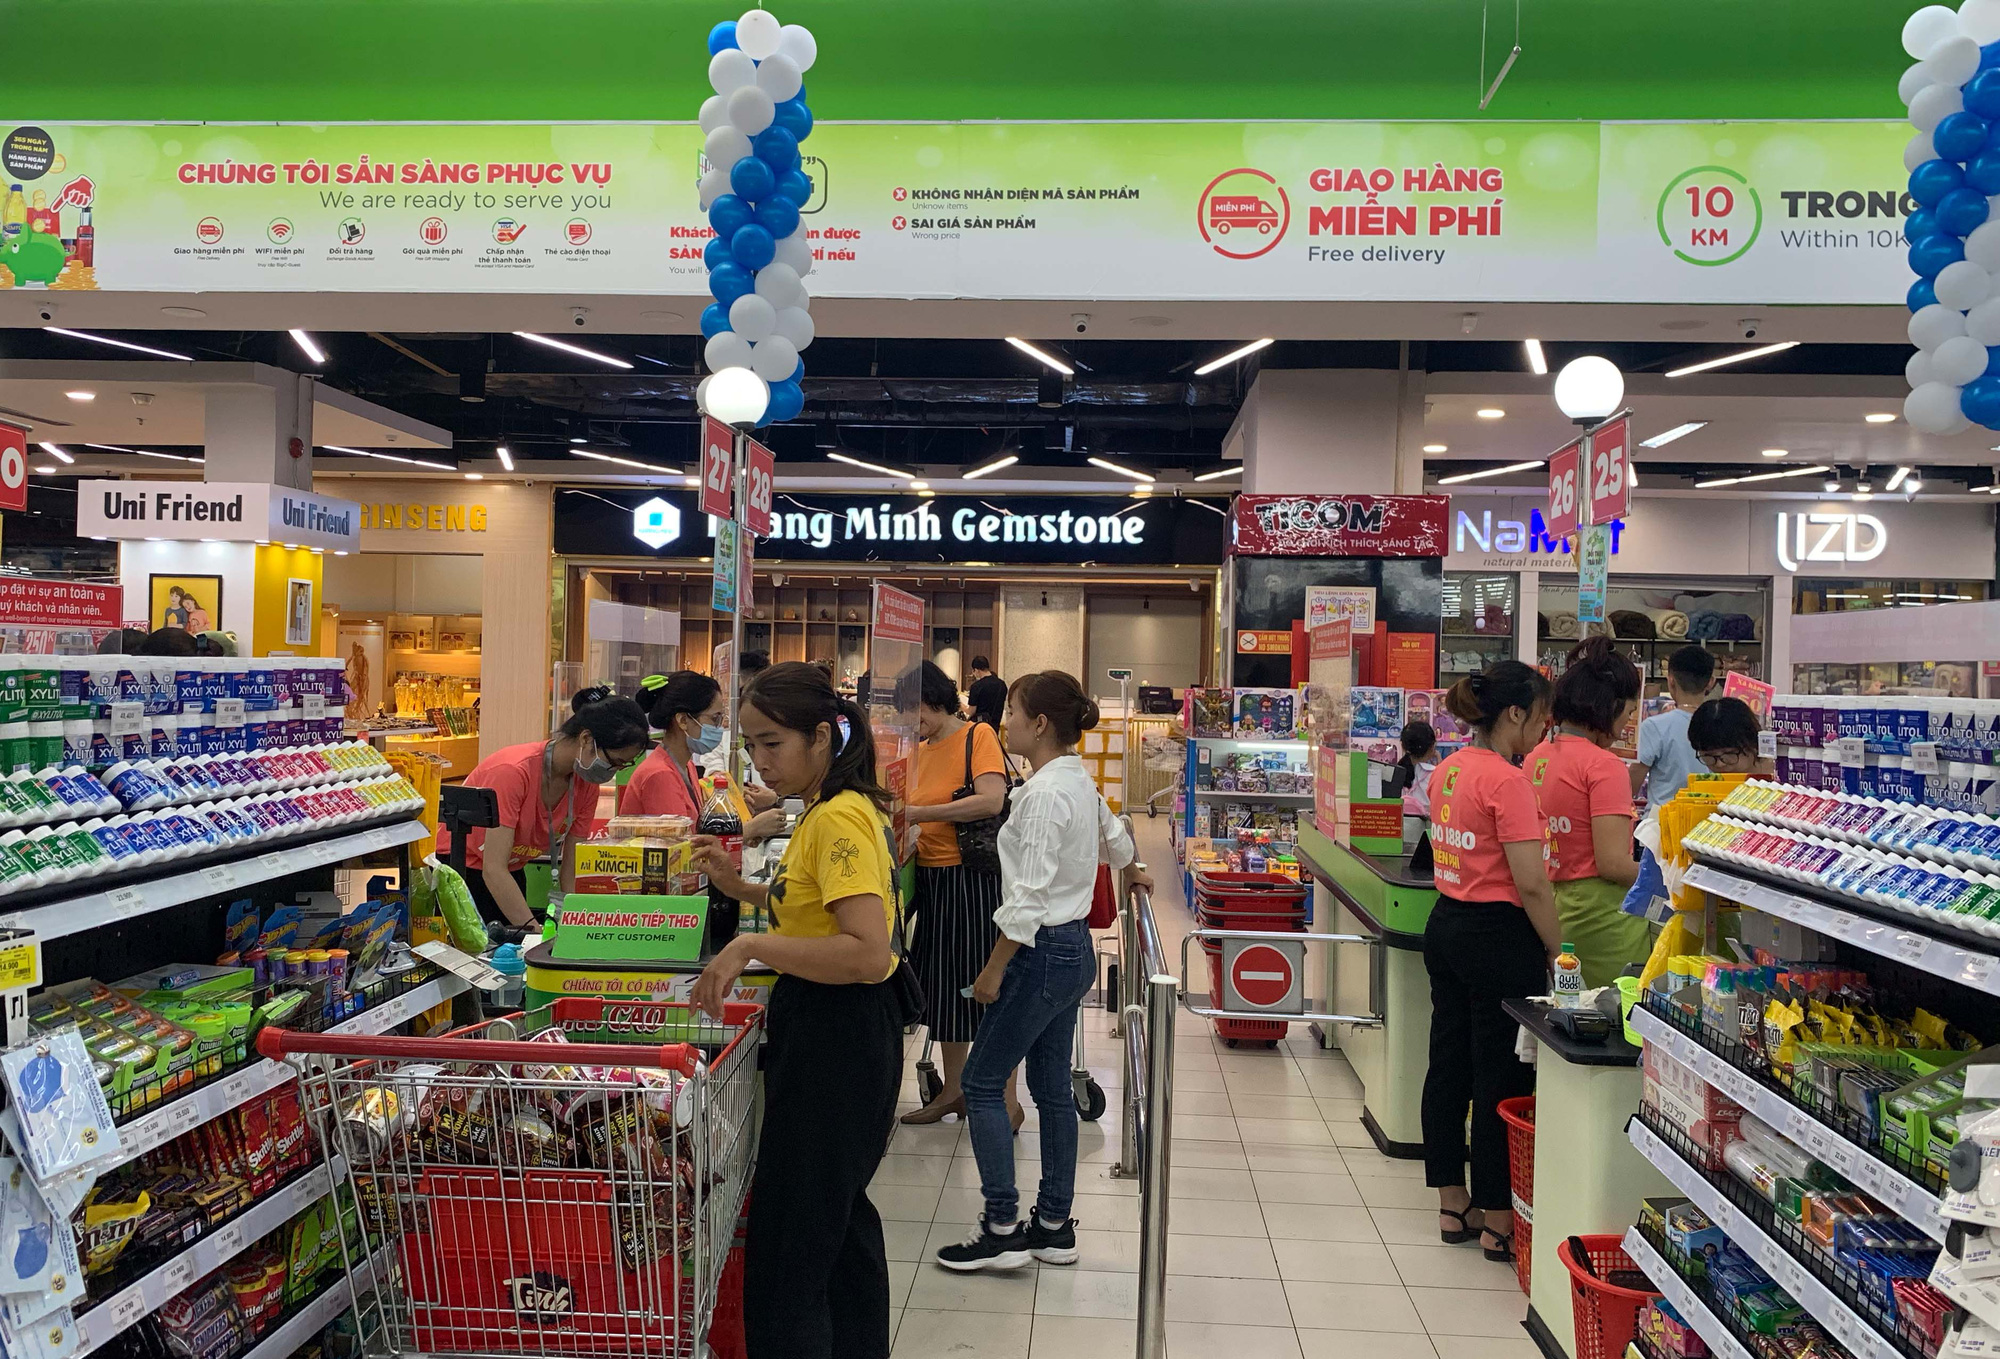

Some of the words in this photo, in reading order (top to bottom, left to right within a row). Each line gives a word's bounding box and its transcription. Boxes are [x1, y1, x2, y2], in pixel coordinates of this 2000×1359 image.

[178, 159, 276, 184] CHÚNG
[283, 159, 329, 184] TÔI
[336, 155, 394, 184] SẴN
[401, 159, 480, 184] SÀNG
[487, 164, 564, 188] PHỤC
[571, 164, 612, 188] VỤ
[1309, 168, 1395, 193] GIAO
[1403, 163, 1503, 192] HÀNG
[320, 191, 354, 208] We
[363, 195, 396, 208] are
[405, 191, 465, 211] ready
[474, 192, 495, 208] to
[504, 195, 562, 208] serve
[571, 195, 612, 212] you
[912, 188, 961, 199] KHÔNG
[964, 188, 1004, 202] NHẬN
[1007, 188, 1039, 202] DIỆN
[1043, 187, 1064, 199] MÃ
[1067, 186, 1096, 199] SẢN
[1100, 184, 1139, 199] PHẨM
[1686, 186, 1734, 218] 10
[947, 202, 968, 210] items
[1216, 201, 1239, 212] MIỄN
[1241, 202, 1255, 212] PHÍ
[1780, 190, 1921, 218] TRONG
[912, 218, 934, 229] SAI
[937, 216, 960, 229] GIÁ
[964, 216, 993, 229] SẢN
[996, 214, 1036, 229] PHẨM
[1309, 193, 1417, 236] MIỄN
[1429, 198, 1504, 236] PHÍ
[670, 226, 717, 238] Khách
[824, 228, 861, 242] được
[912, 231, 938, 240] Wrong
[941, 231, 960, 240] price
[1692, 228, 1728, 246] KM
[1780, 229, 1858, 248] Within
[193, 247, 212, 256] hàng
[213, 246, 231, 254] miễn
[233, 247, 245, 255] phí
[274, 246, 292, 254] miễn
[293, 247, 304, 255] phí
[355, 247, 373, 256] hàng
[417, 248, 430, 256] quà
[432, 246, 450, 254] miễn
[451, 247, 463, 255] phí
[486, 246, 504, 256] Chấp
[506, 248, 524, 256] nhận
[574, 248, 590, 256] điện
[592, 248, 611, 256] thoại
[669, 245, 702, 259] SẢN
[828, 250, 855, 261] nếu
[1309, 246, 1354, 261] Free
[1362, 246, 1445, 264] delivery
[687, 266, 704, 274] will
[708, 443, 730, 494] 27
[1594, 446, 1623, 501] 25
[750, 466, 770, 514] 28
[1550, 469, 1574, 520] 26
[104, 492, 145, 520] Uni
[156, 494, 242, 522] Friend
[282, 498, 305, 525] Uni
[308, 501, 350, 536] Friend
[360, 503, 487, 531] GINSENG
[844, 504, 942, 542] Minh
[952, 506, 1145, 545] Gemstone
[1350, 538, 1380, 548] THÍCH
[1382, 538, 1410, 548] SÁNG
[1484, 558, 1526, 567] natural
[10, 583, 26, 598] đặt
[28, 585, 36, 596] vì
[39, 587, 51, 598] sự
[54, 588, 67, 598] an
[70, 586, 93, 600] toàn
[96, 589, 105, 600] và
[0, 600, 12, 613] uý
[15, 601, 43, 613] khách
[45, 601, 56, 613] và
[59, 604, 80, 615] nhân
[82, 604, 102, 616] viên.
[1446, 827, 1476, 850] 1880
[594, 860, 638, 873] KIMCHI
[562, 909, 602, 926] KHÁCH
[605, 909, 638, 927] HÀNG
[641, 909, 666, 927] TIẾP
[669, 914, 699, 928] THEO
[586, 932, 614, 941] NEXT
[618, 933, 676, 942] CUSTOMER
[562, 978, 603, 991] CHÚNG
[606, 979, 623, 991] TÔI
[627, 979, 642, 991] CÓ
[646, 979, 670, 992] BÁN
[193, 1311, 228, 1347] SNICKERS
